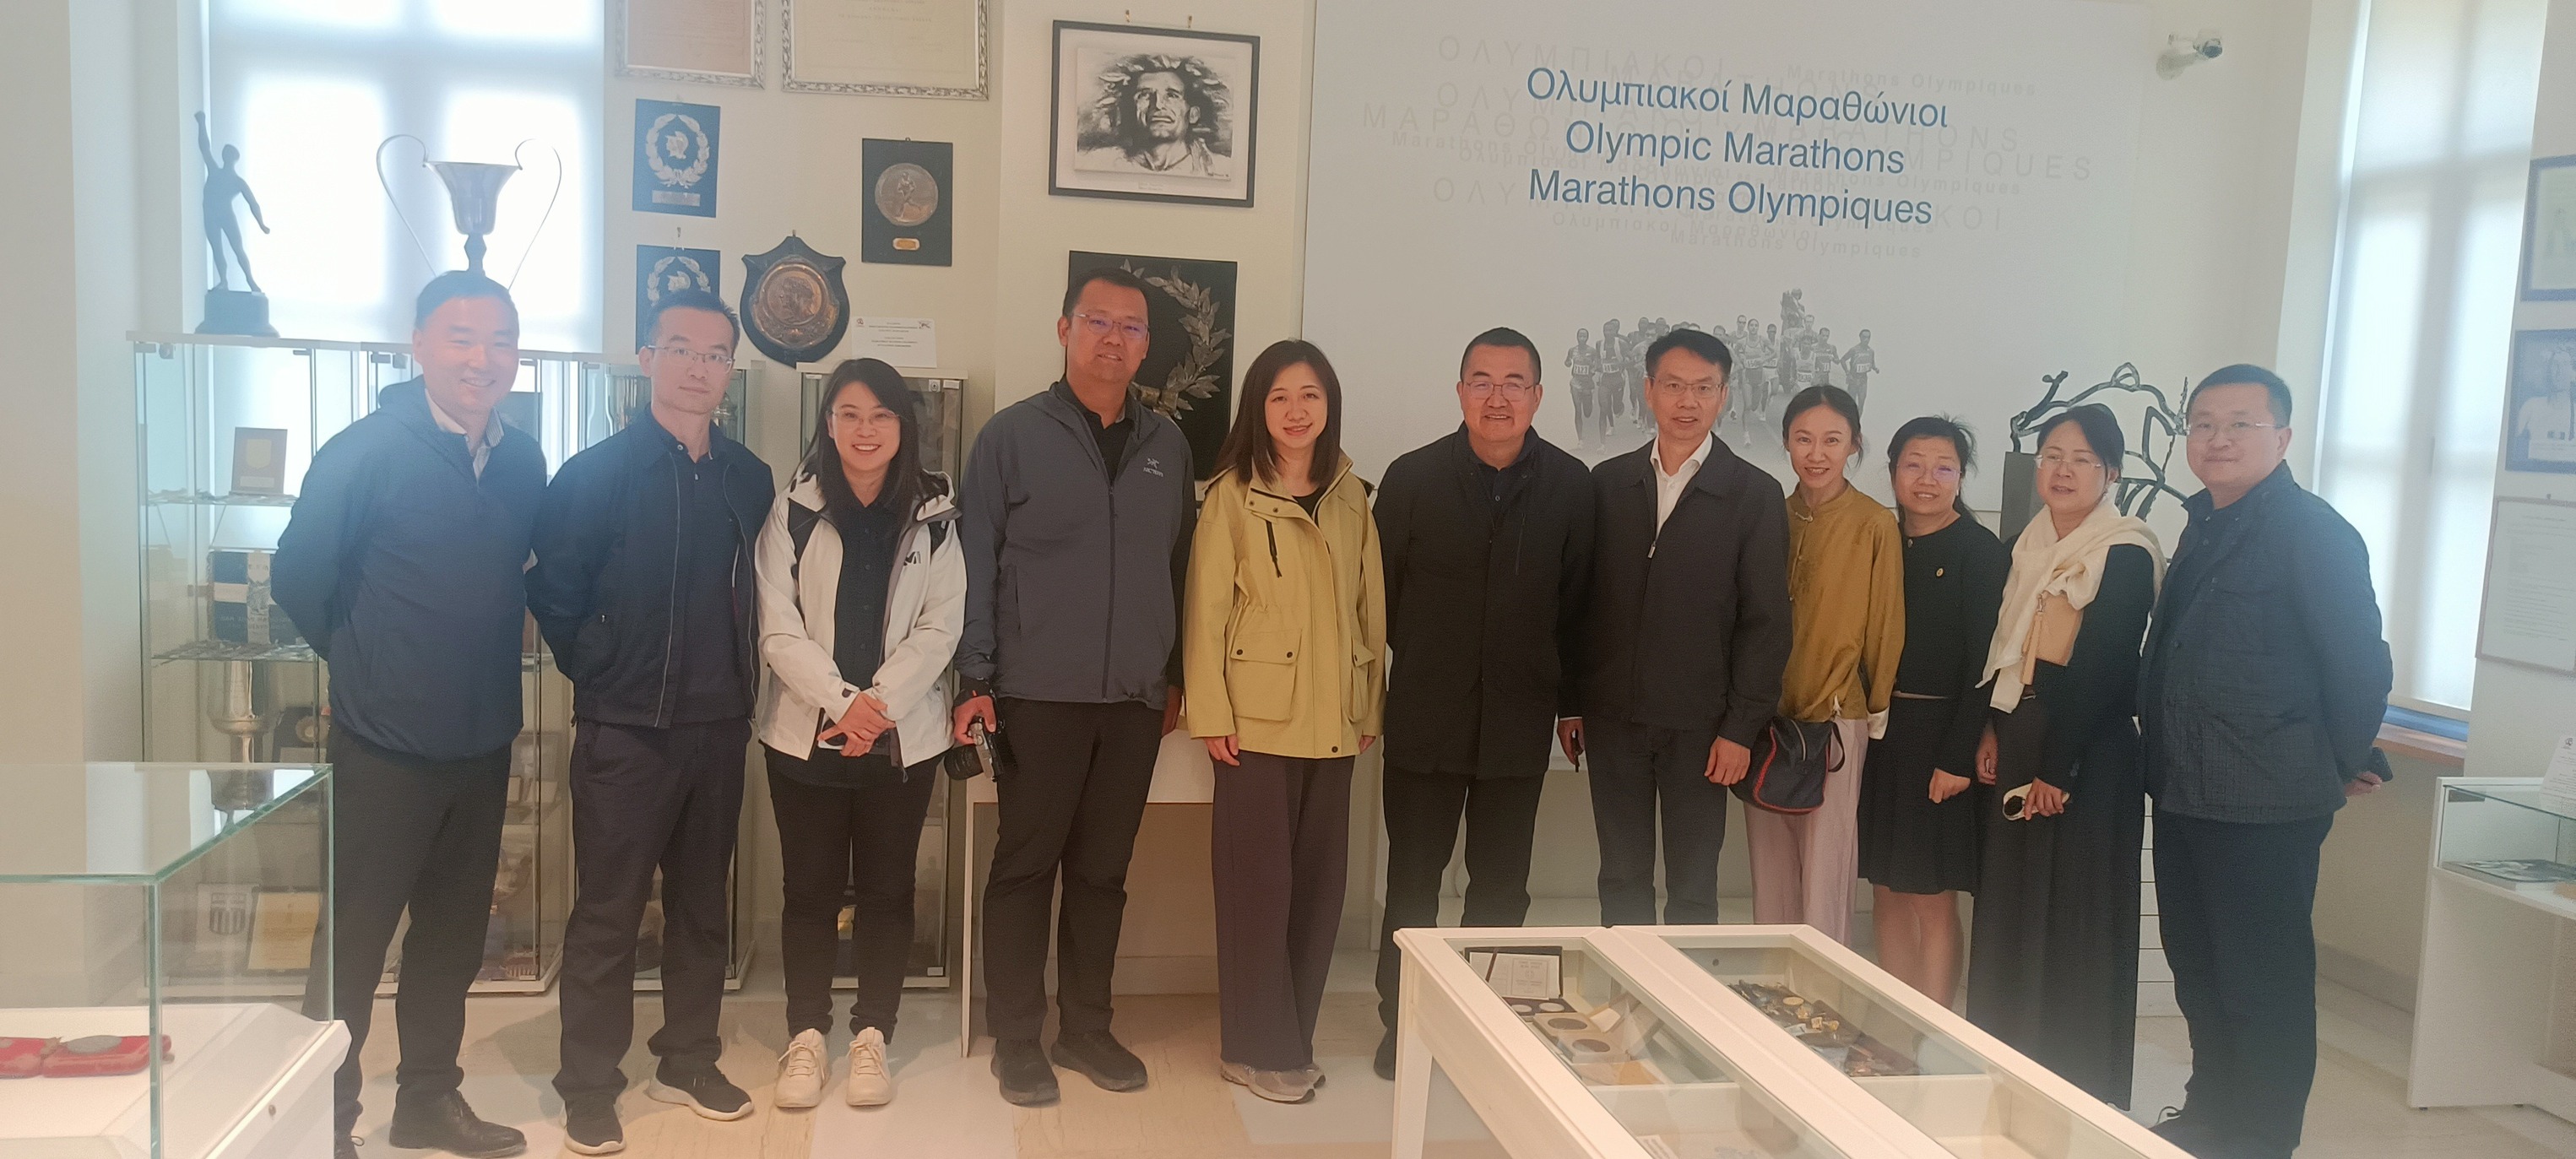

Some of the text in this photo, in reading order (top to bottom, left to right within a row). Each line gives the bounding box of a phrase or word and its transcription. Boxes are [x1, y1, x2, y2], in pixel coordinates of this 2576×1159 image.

[1527, 66, 1948, 128] Ολυμπιακοί Μαραθώνιοι
[1912, 73, 2036, 96] Olympiques
[1565, 119, 1711, 167] Olympic
[1724, 130, 1905, 174] Marathons
[1529, 168, 1715, 211] Marathons
[1728, 180, 1933, 230] Olympiques
